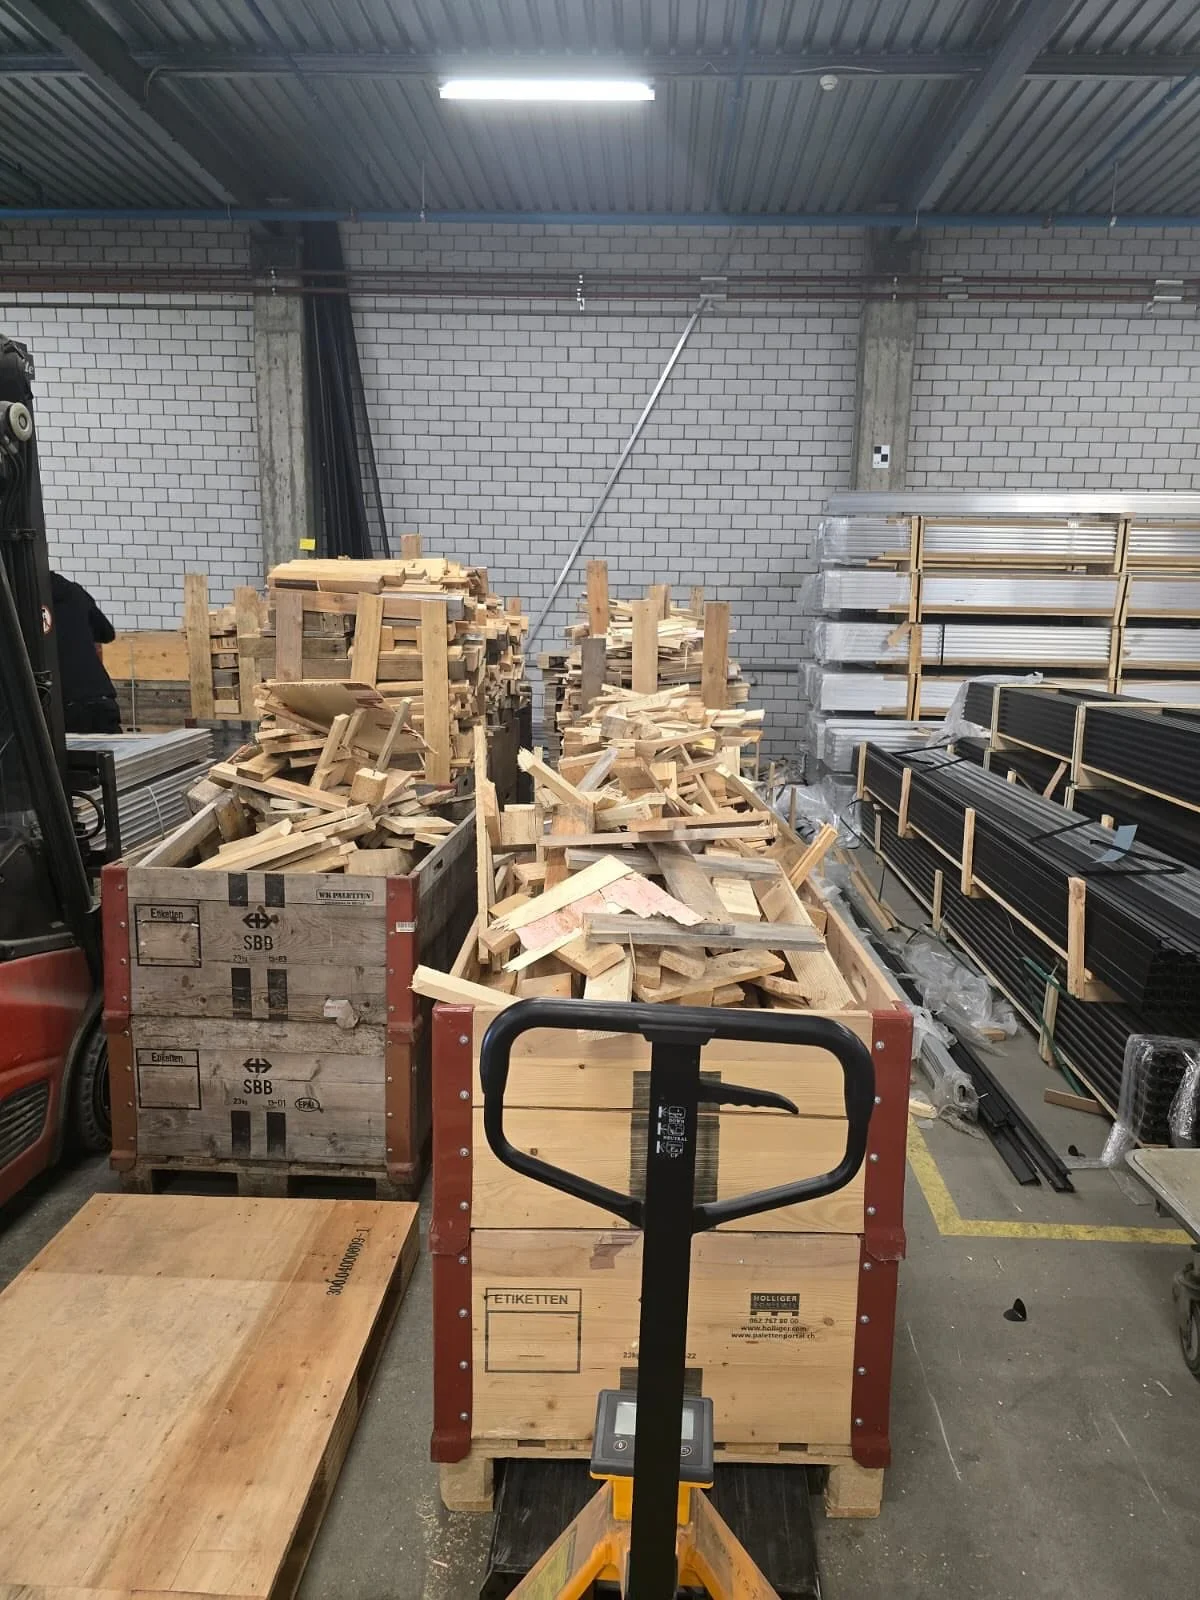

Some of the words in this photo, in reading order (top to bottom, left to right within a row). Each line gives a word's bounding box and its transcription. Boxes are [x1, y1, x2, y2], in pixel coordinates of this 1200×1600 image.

[243, 935, 274, 950] SBB
[243, 1079, 273, 1095] SBB
[494, 1294, 568, 1305] ETIKETTEN
